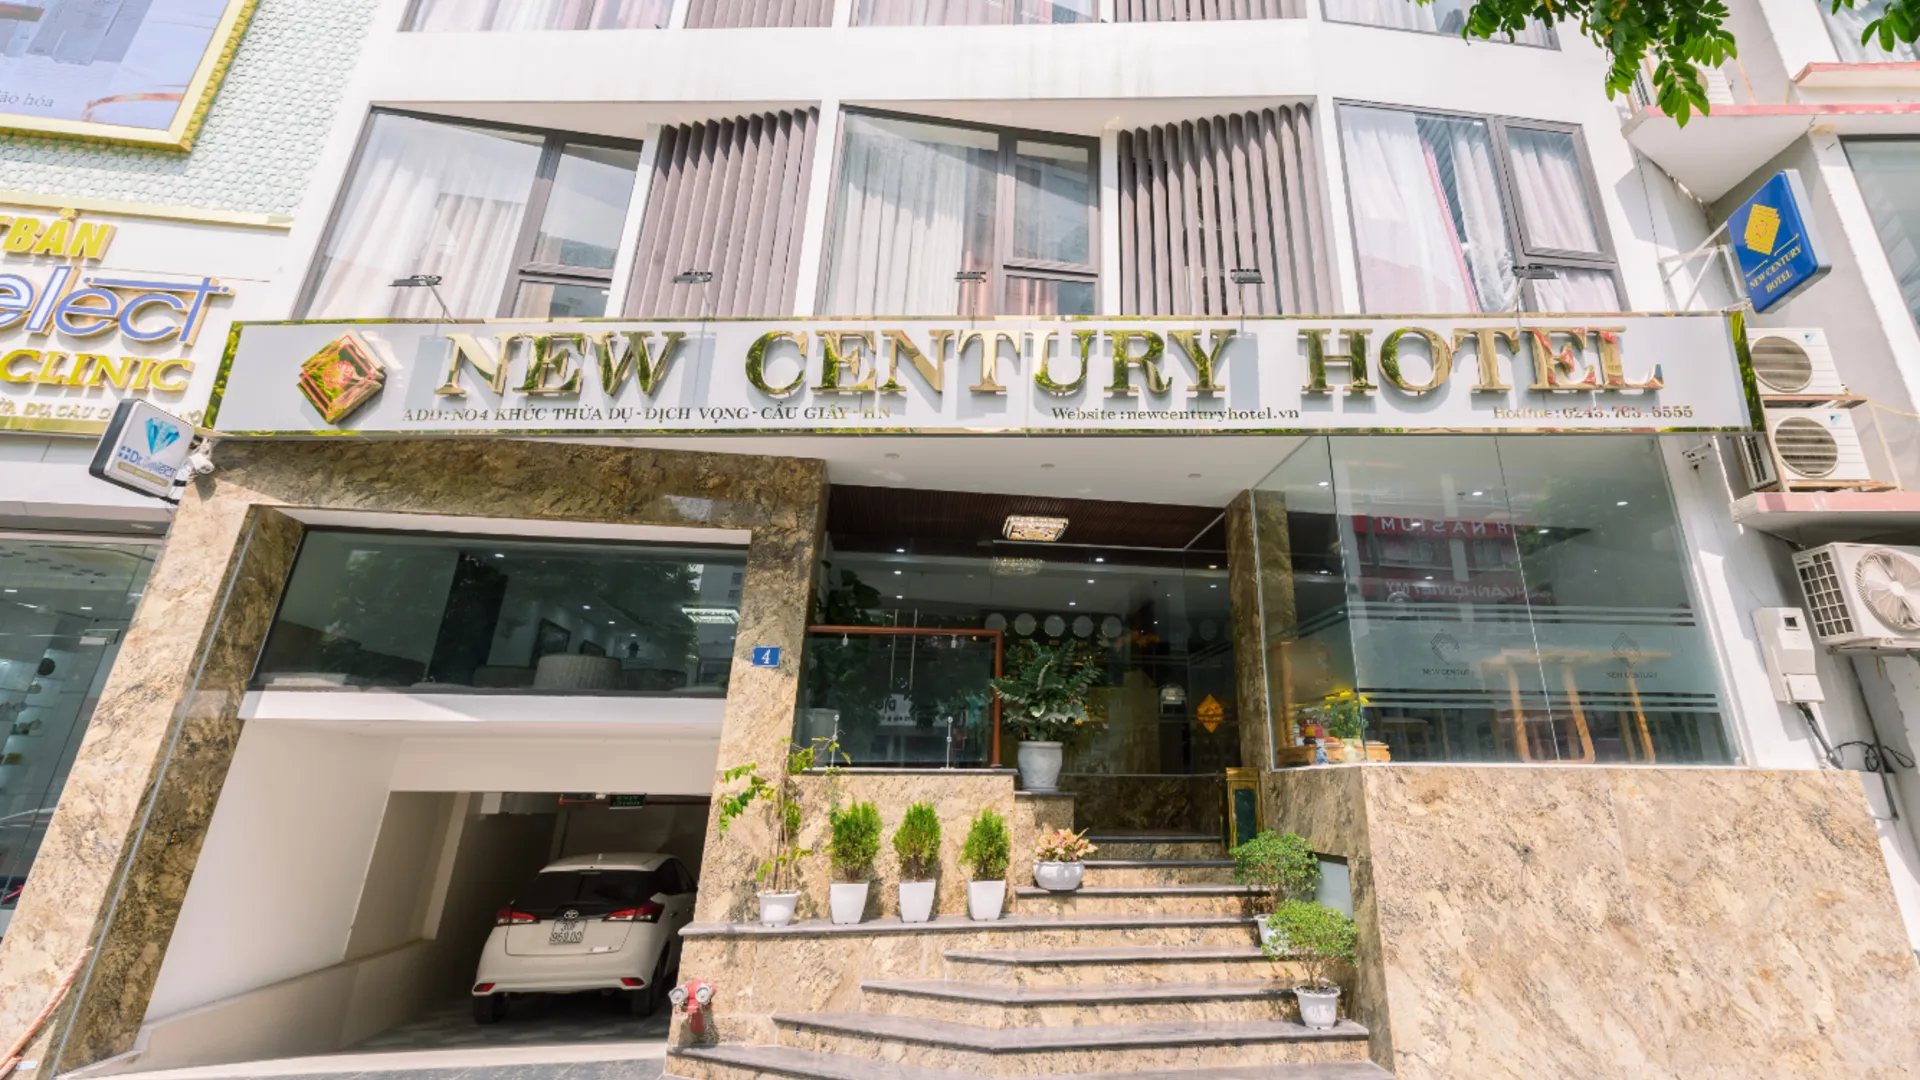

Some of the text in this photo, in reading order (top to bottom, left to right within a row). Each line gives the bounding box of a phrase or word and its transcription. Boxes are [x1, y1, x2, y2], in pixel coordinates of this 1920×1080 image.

[1750, 243, 1802, 288] NEW CENTURY
[1766, 269, 1793, 292] HOTEL
[435, 327, 1664, 397] NEW CENTURY HOTEL
[761, 648, 771, 664] 4
